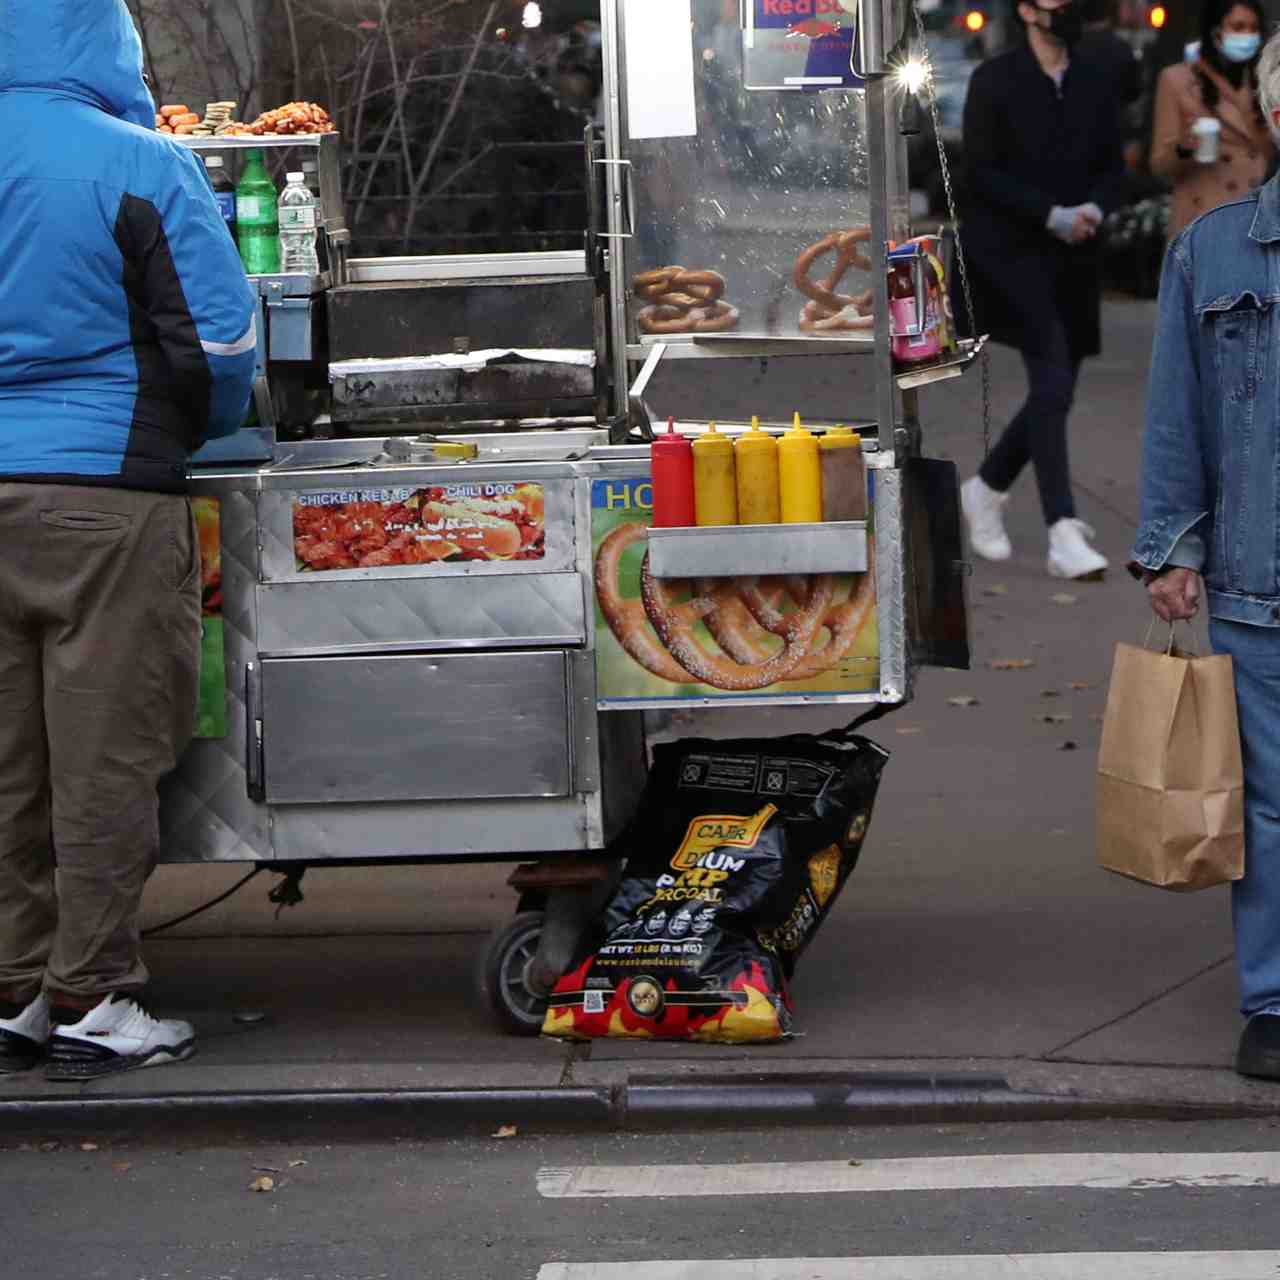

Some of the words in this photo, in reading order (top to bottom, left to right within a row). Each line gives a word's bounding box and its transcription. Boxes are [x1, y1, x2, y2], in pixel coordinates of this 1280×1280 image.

[445, 485, 483, 497] CHILI
[486, 483, 515, 494] DOG
[298, 493, 358, 506] CHICKEN
